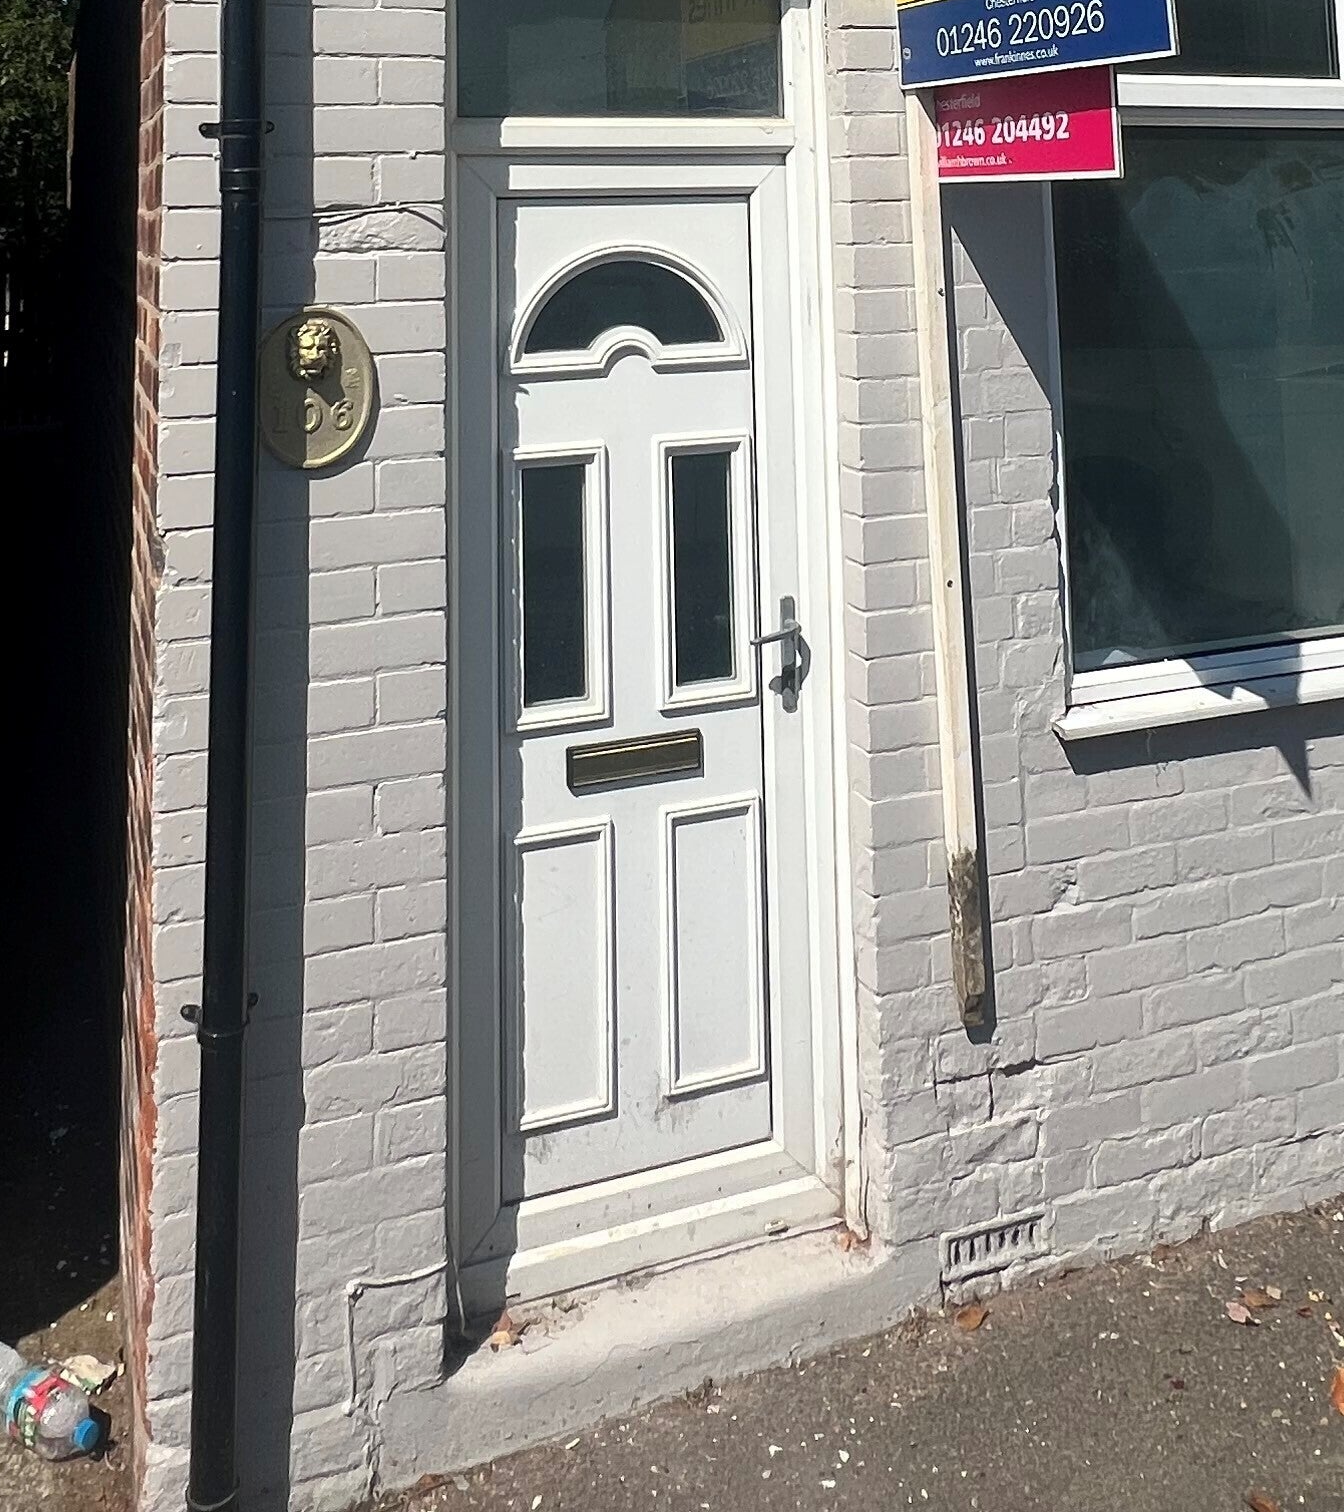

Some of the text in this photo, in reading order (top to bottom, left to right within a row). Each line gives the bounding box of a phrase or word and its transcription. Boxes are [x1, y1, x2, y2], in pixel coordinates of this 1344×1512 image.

[936, 0, 1105, 56] 01246 220926
[974, 44, 1059, 67] www.frankinnes.co.uk
[991, 110, 1070, 144] 204492
